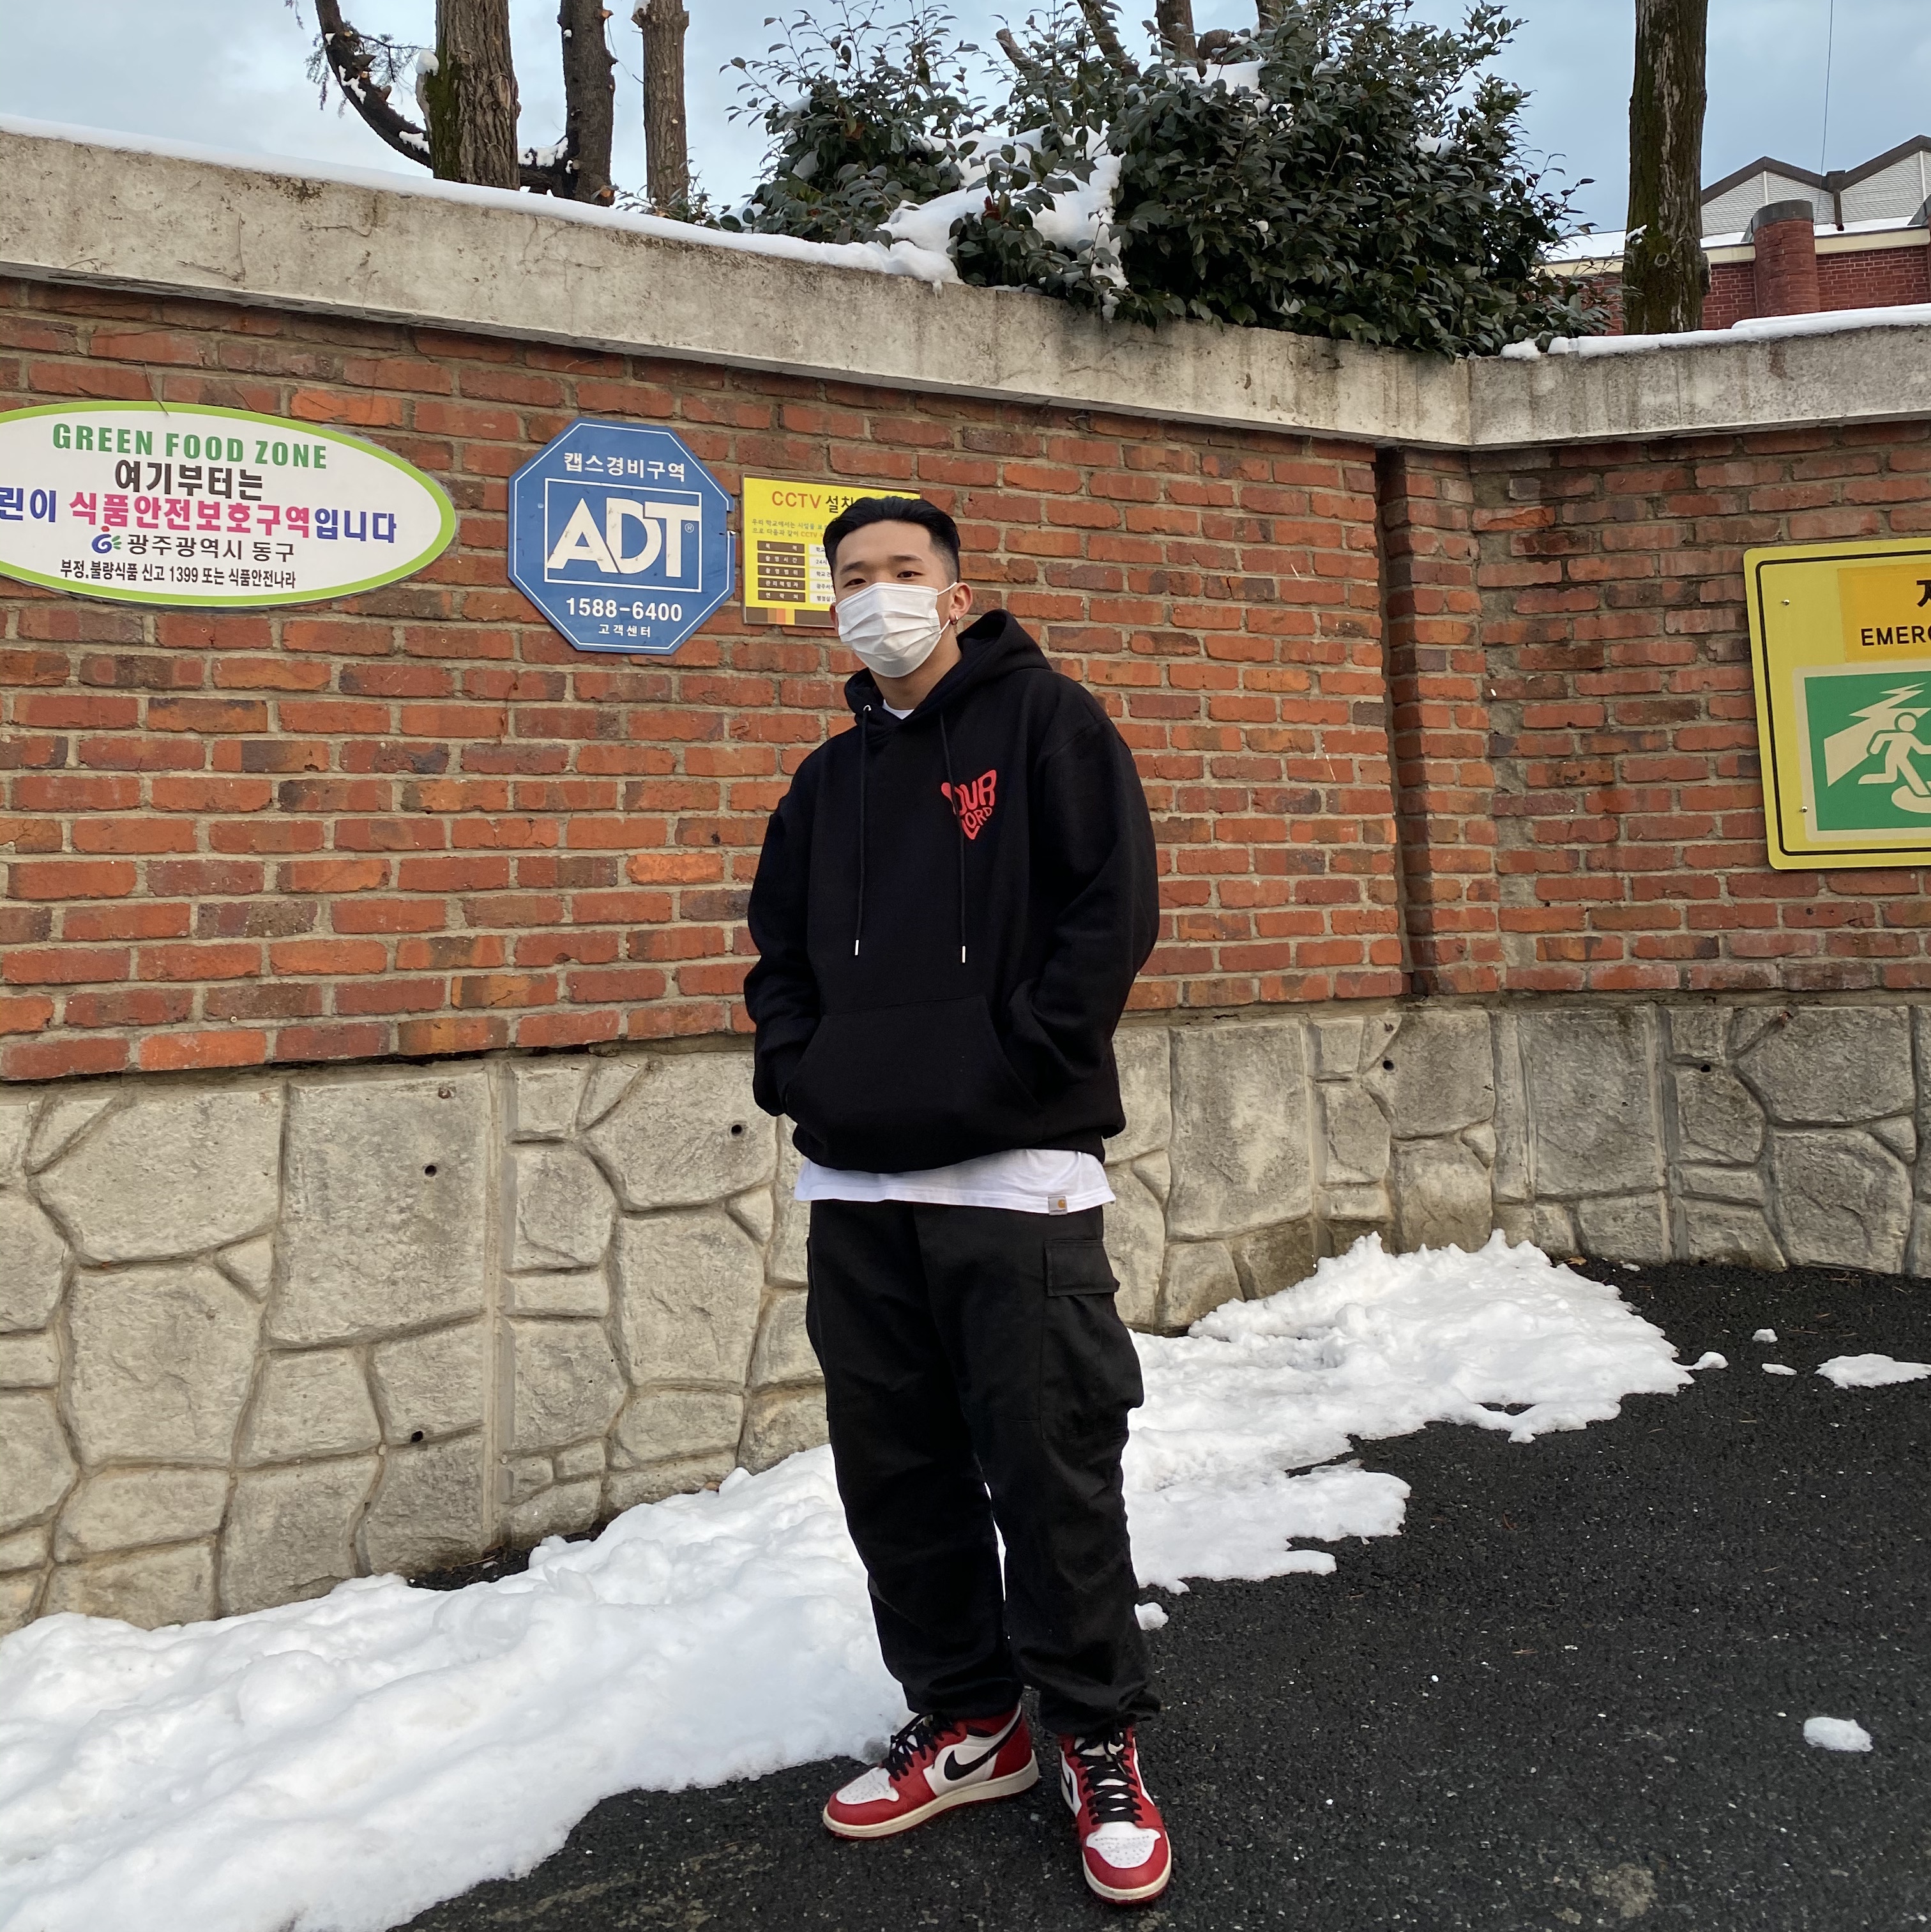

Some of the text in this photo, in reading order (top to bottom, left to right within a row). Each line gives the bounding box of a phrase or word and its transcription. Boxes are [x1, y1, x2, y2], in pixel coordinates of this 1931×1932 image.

[53, 423, 327, 469] GREEN FOOD ZONE
[115, 459, 262, 501] 여기부터는
[564, 452, 685, 482] 캡스경비구역
[771, 491, 822, 509] CCTV
[69, 492, 397, 544] 식품안전보호구역입니다
[128, 534, 294, 563] 광주광역시 동구
[547, 497, 700, 578] ADT
[142, 563, 165, 581] 신고
[169, 566, 198, 582] 1399
[202, 567, 224, 585] 또는
[229, 568, 296, 589] 식품안전나라
[566, 597, 682, 622] 1588-6400
[598, 623, 651, 638] 고객센터
[1861, 625, 1931, 646] EMER
